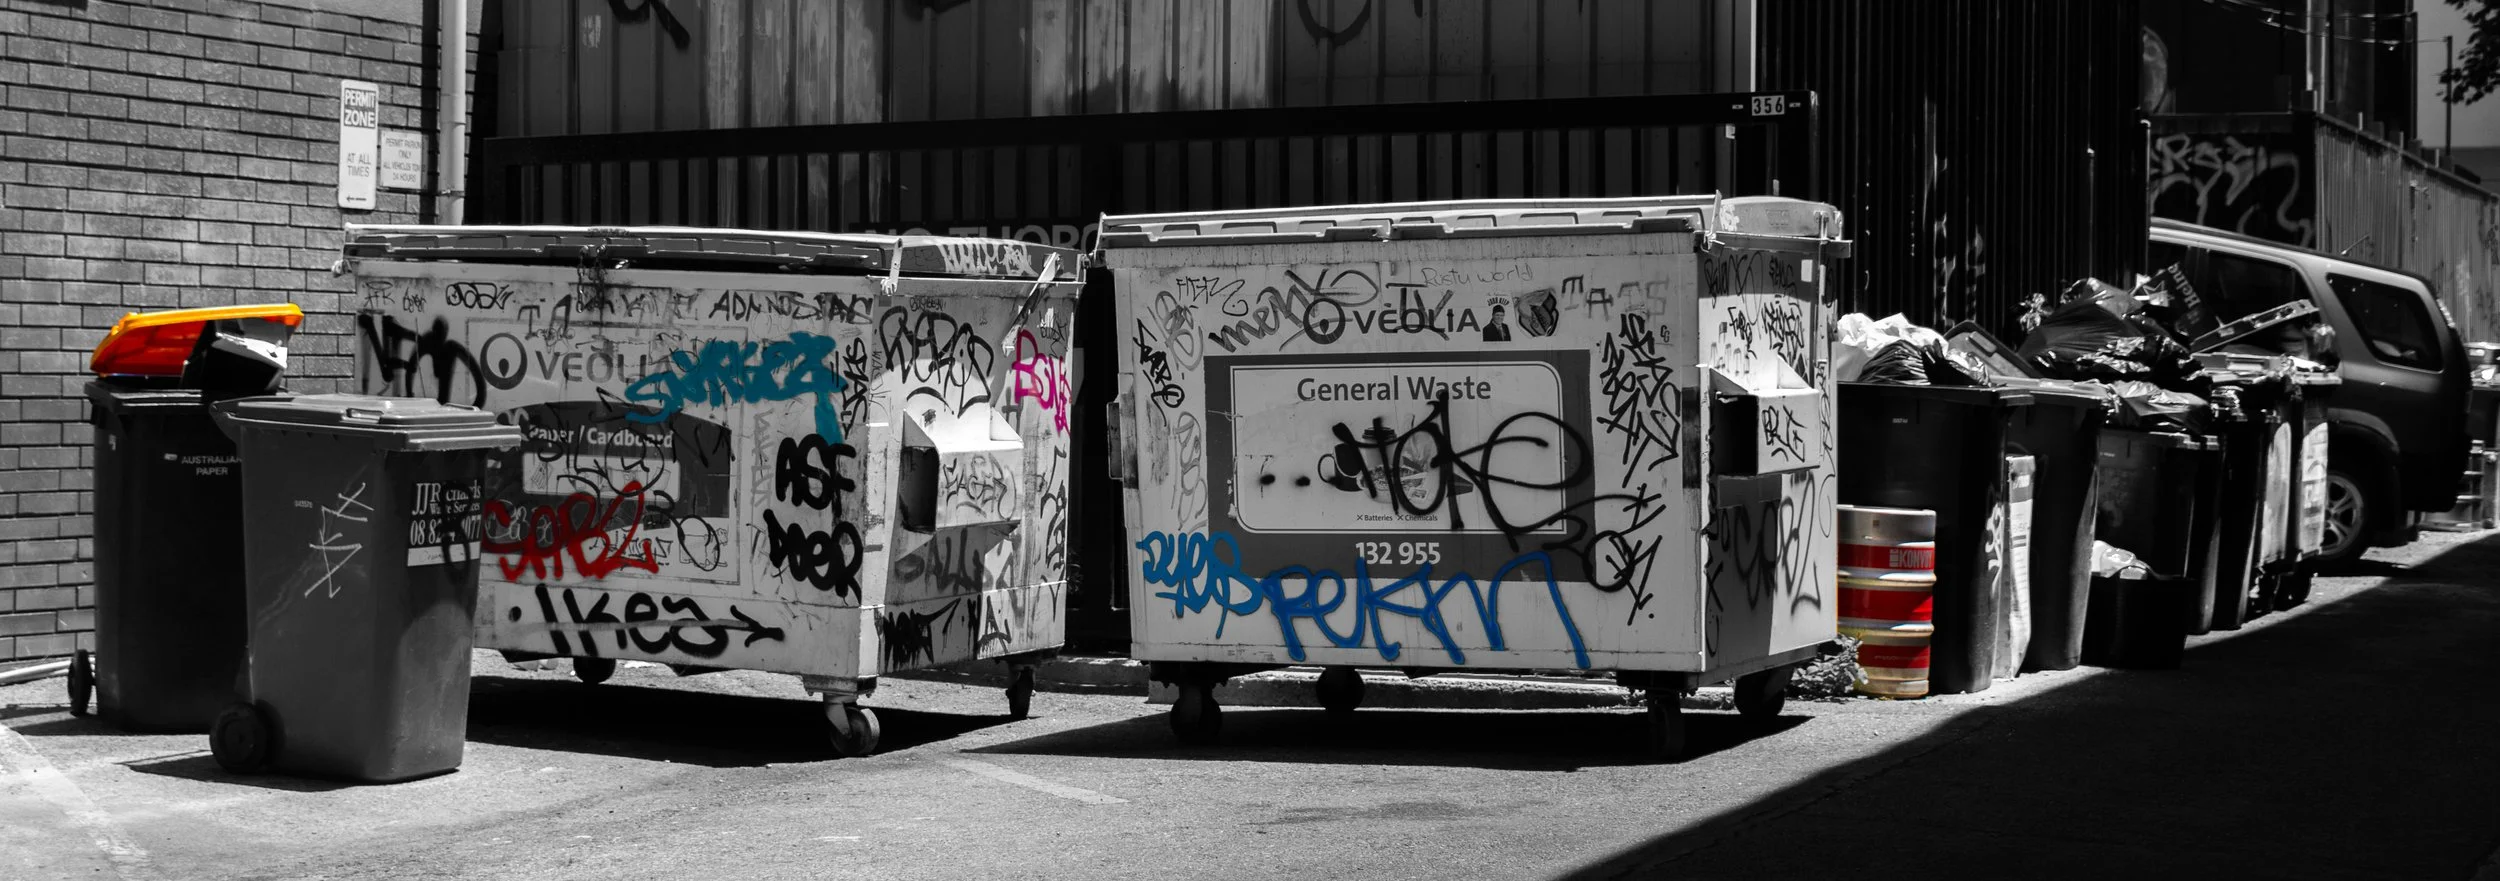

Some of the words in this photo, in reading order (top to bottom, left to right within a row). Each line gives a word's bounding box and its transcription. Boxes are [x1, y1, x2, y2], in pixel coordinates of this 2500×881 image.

[345, 90, 376, 108] PERMIT
[1753, 98, 1783, 114] 356
[344, 109, 375, 127] ZONE
[347, 153, 356, 164] AT
[359, 153, 371, 165] ALL
[347, 165, 370, 177] TIMES
[535, 350, 662, 384] VEOLI
[1297, 376, 1399, 402] General
[1407, 375, 1492, 400] Waste
[196, 467, 229, 475] PAPER
[1404, 514, 1438, 522] Chemicals
[410, 519, 425, 546] 08
[1355, 541, 1393, 565] 132
[1398, 541, 1441, 565] 955
